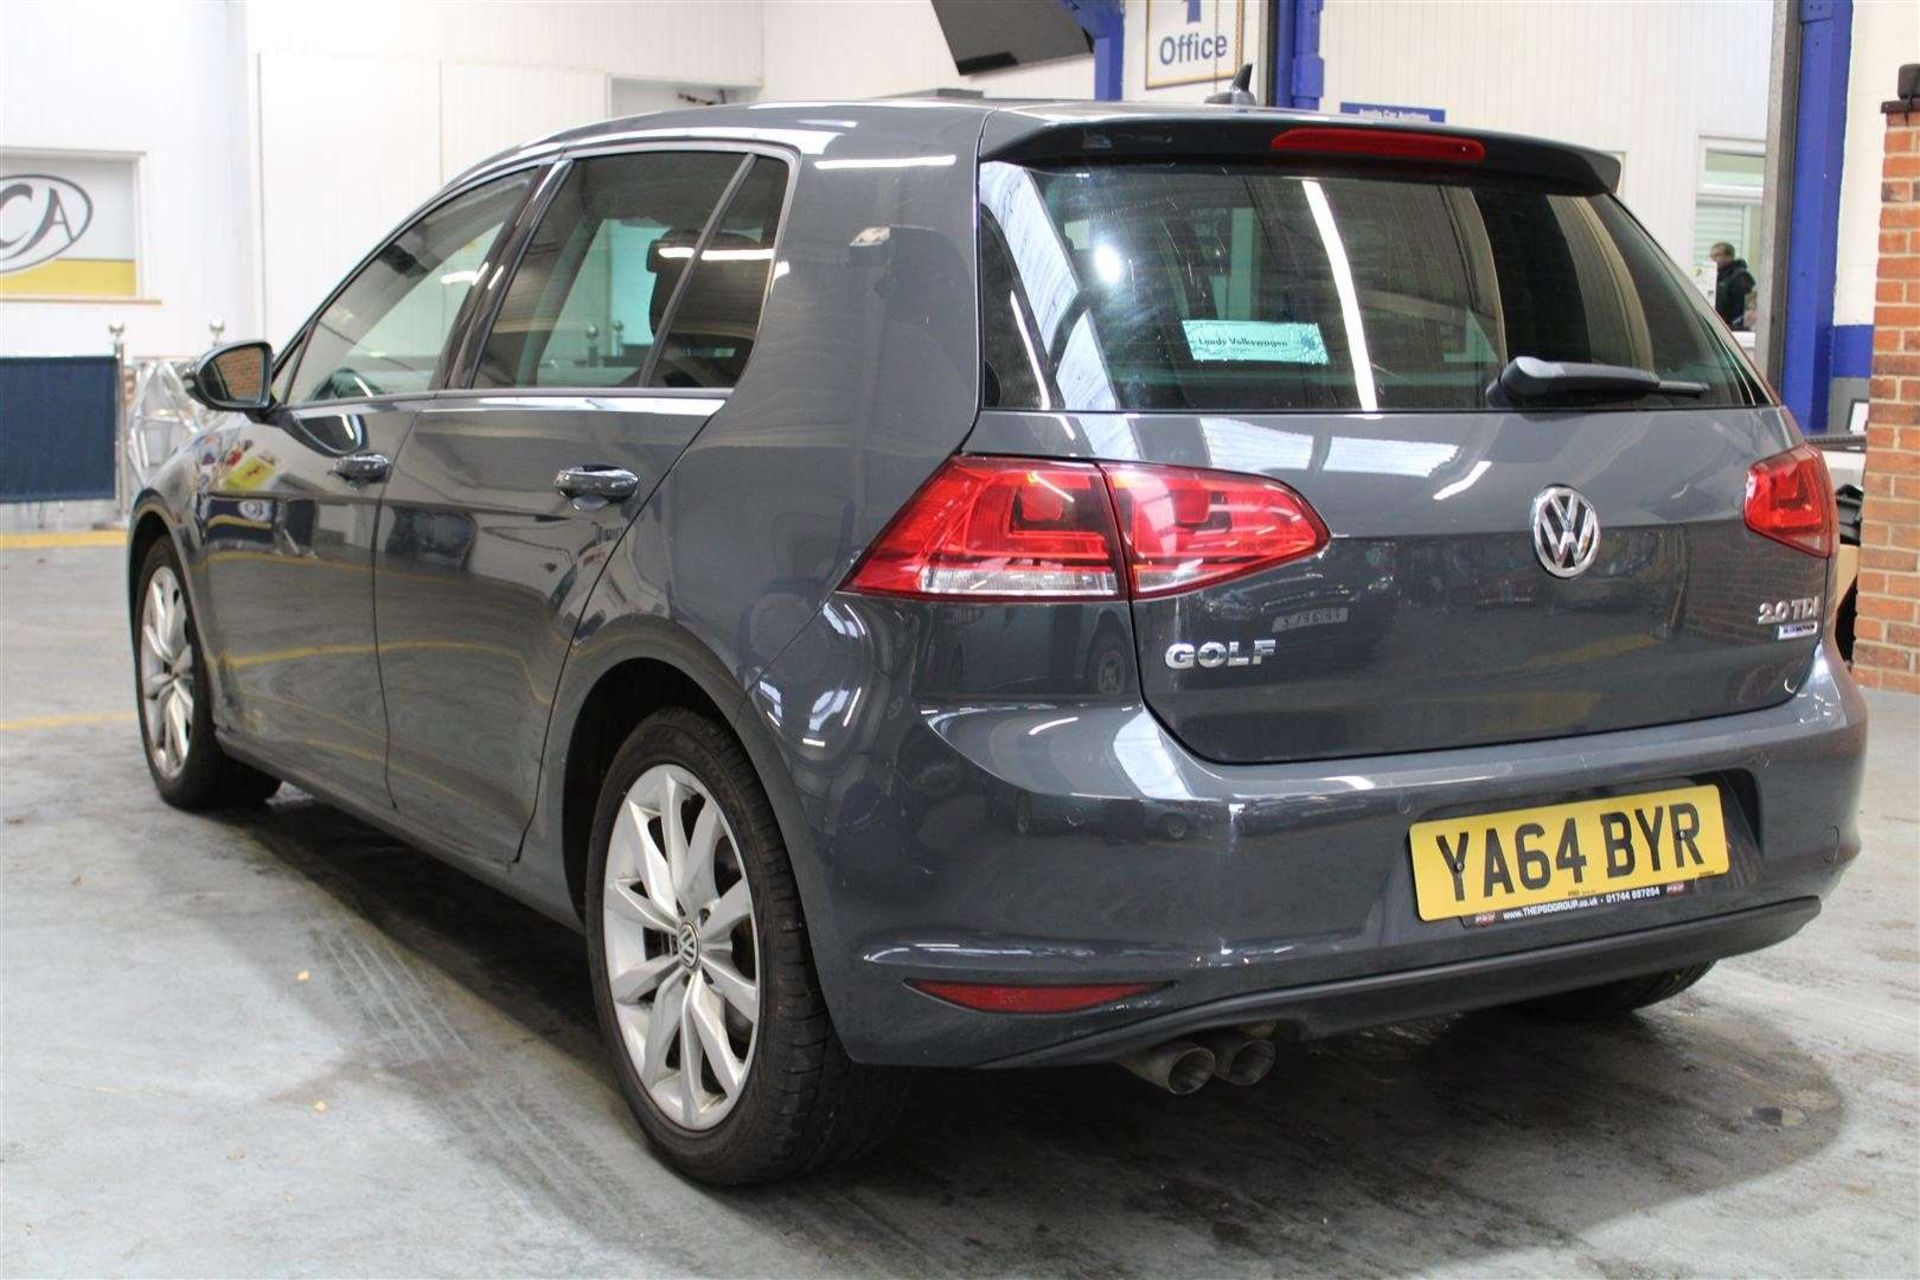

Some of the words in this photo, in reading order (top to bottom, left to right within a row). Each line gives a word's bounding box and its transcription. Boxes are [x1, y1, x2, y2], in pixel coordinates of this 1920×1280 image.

[1160, 32, 1227, 66] Office
[1229, 337, 1288, 349] Volkswagen
[1791, 596, 1819, 621] TDI
[1164, 639, 1276, 670] GOLF
[1436, 817, 1587, 901] YA64
[1600, 802, 1704, 879] BYR
